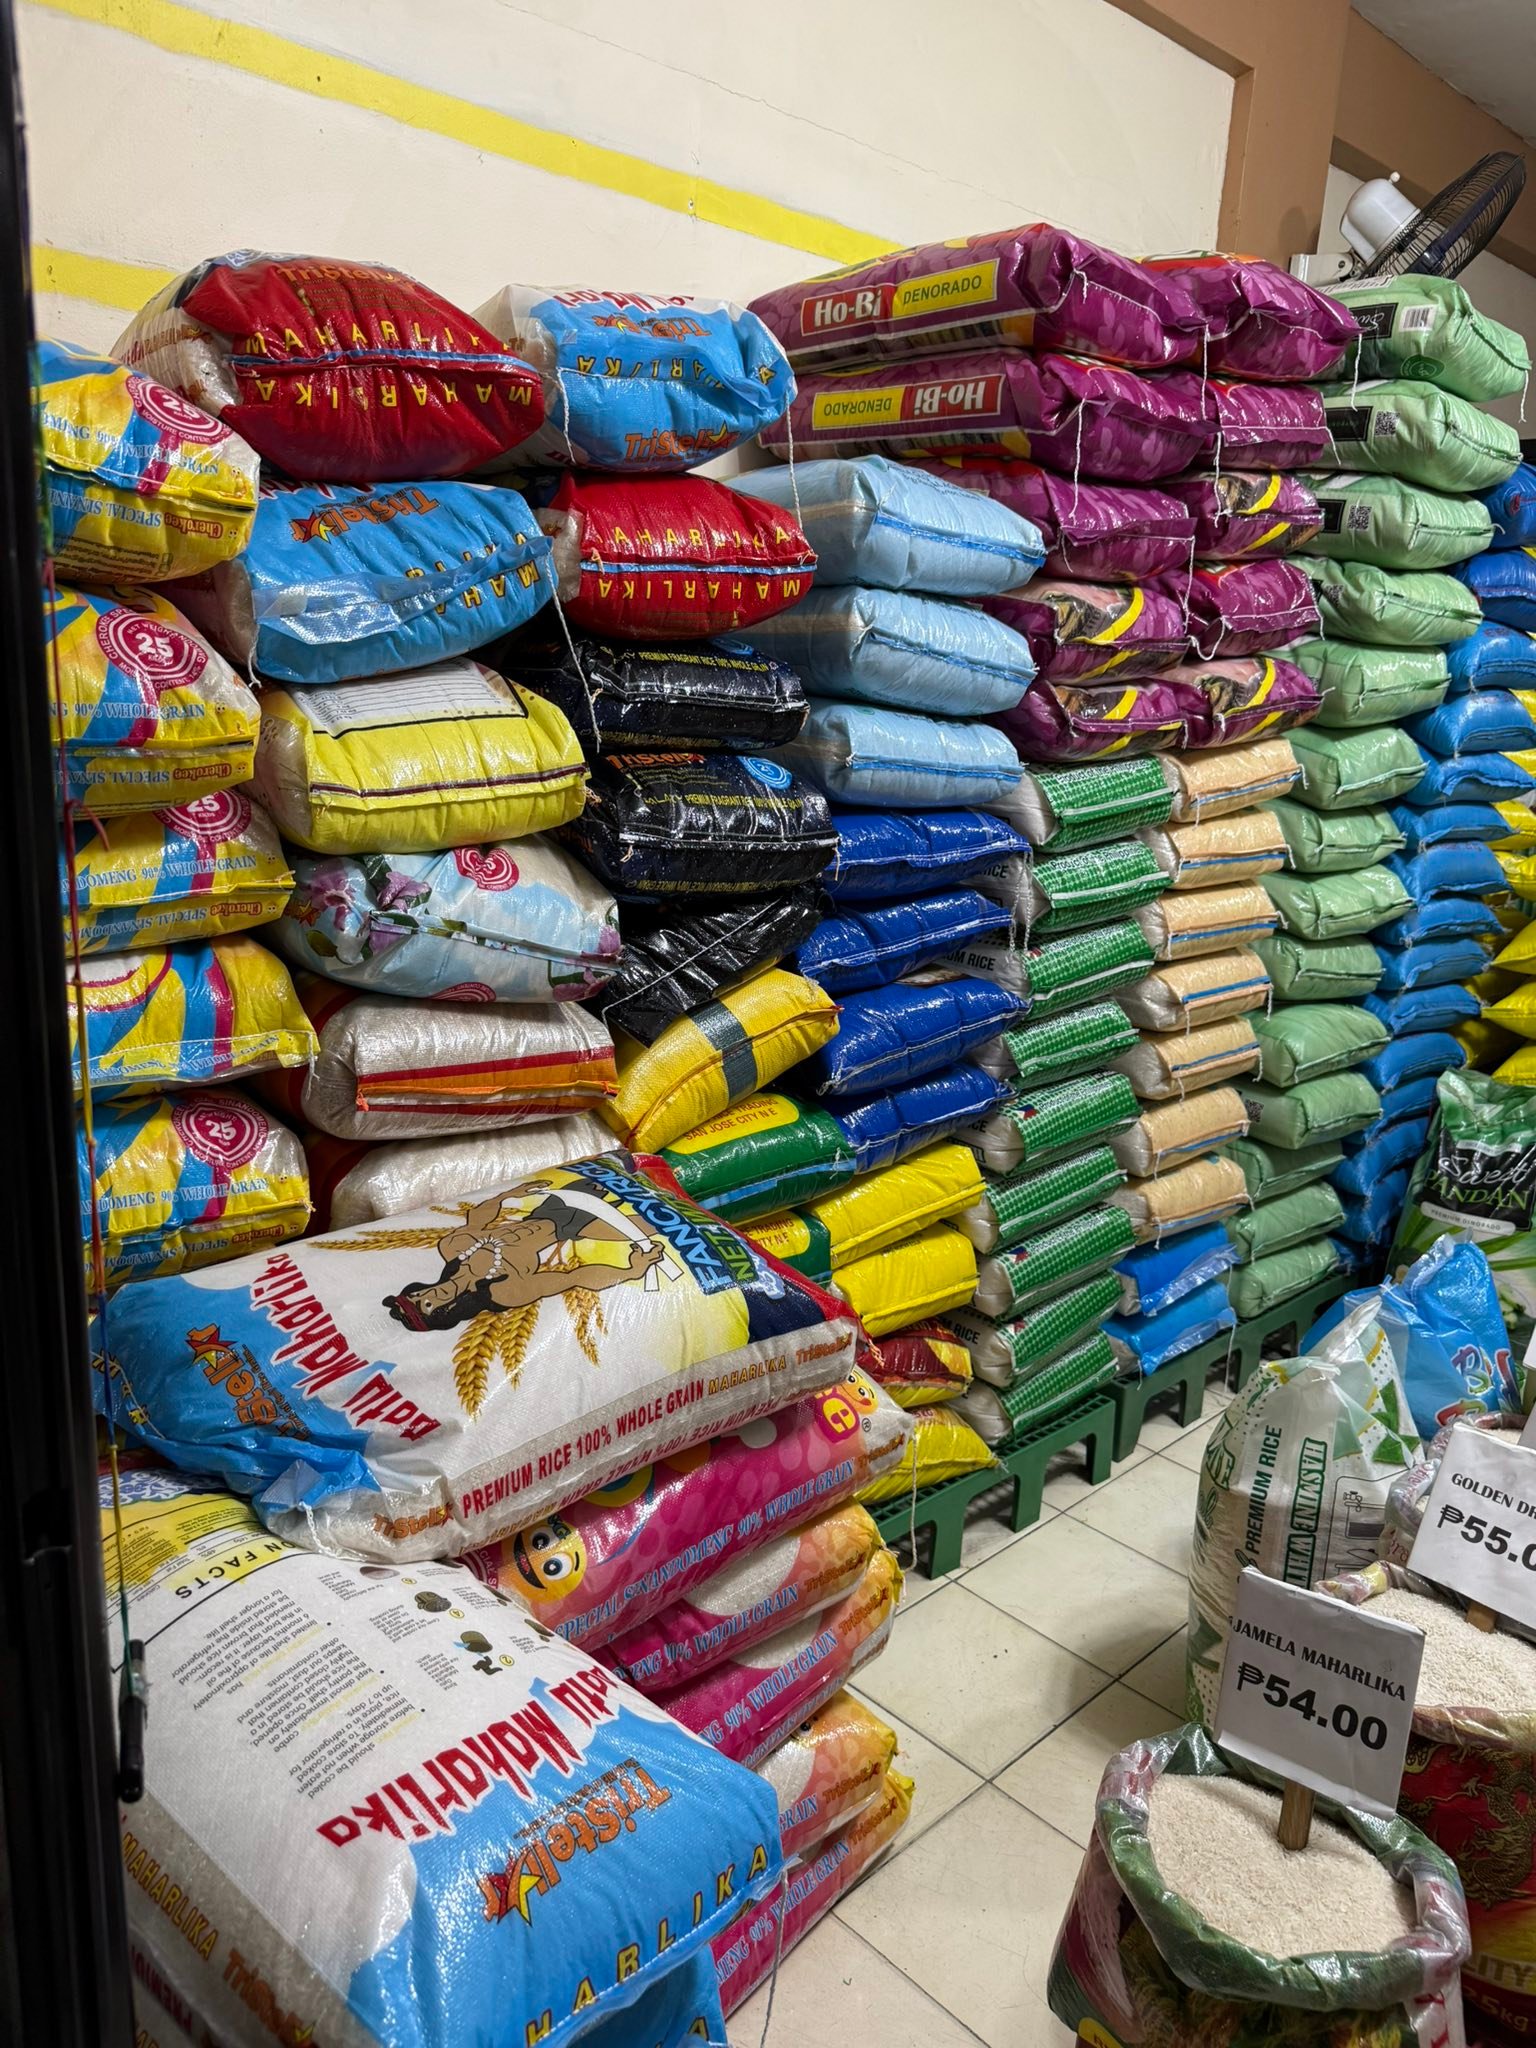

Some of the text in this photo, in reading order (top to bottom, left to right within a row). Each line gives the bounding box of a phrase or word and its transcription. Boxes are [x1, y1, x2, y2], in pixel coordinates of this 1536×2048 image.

[814, 275, 982, 328] Ho-Bi DENORADO
[823, 381, 985, 416] Ho-Bi DENORADO
[105, 501, 161, 527] SPECIAL
[165, 514, 222, 538] Cherokee
[598, 580, 801, 600] MAHARLIKA
[135, 632, 174, 658] 25
[74, 704, 102, 717] 90%
[111, 763, 232, 784] Cherokee SPECIAL
[141, 866, 166, 880] 90%
[217, 855, 256, 871] GRAIN
[155, 901, 262, 924] Cherokee SPECIAL
[968, 952, 997, 970] RICE
[684, 1128, 706, 1140] SAN
[710, 1119, 736, 1133] JOSE
[738, 1112, 759, 1124] CITY
[735, 1098, 778, 1114] TRADING
[206, 1120, 237, 1139] 25
[231, 1179, 270, 1195] GRAIN
[632, 1199, 732, 1292] FANCY
[754, 1218, 794, 1233] TRADING
[252, 1252, 369, 1397] Maharlika
[955, 1324, 981, 1344] RICE
[462, 1355, 787, 1519] PREMIUM RICE 100% WHOLE GRAIN MAHARLIKA
[766, 1480, 813, 1517] WHOLE
[814, 1456, 855, 1495] GRAIN
[1245, 1425, 1282, 1554] PREMIUM RICE
[1451, 1473, 1514, 1508] GOLDEN
[174, 1550, 258, 1600] FACTS
[237, 1596, 264, 1620] longer
[752, 1584, 799, 1623] GRAIN
[168, 1598, 278, 1680] stored inside the refrigerator
[177, 1597, 295, 1686] mended that brown rice should
[216, 1614, 303, 1678] months because the
[238, 1618, 281, 1651] bran layer.
[191, 1616, 317, 1711] limited shelf approximately
[264, 1635, 339, 1692] other contaminants.
[748, 1664, 798, 1712] WHOLE
[797, 1627, 838, 1670] GRAIN
[1233, 1616, 1406, 1701] JAMELA MAHARLIKA
[226, 1680, 243, 1696] has
[236, 1640, 346, 1724] keeps dust, moisture and
[246, 1646, 353, 1727] highly closed that
[266, 1662, 346, 1723] rice should be stored
[283, 1666, 352, 1721] pantry shelf. Once
[343, 1682, 392, 1721] up days.
[381, 1688, 400, 1705] rice,
[267, 1665, 373, 1745] kept almost immediately on
[360, 1699, 383, 1720] place
[1238, 1661, 1387, 1751] ₱54.00
[272, 1729, 300, 1753] canbe
[295, 1693, 407, 1782] immediately. To store cooked
[296, 1702, 414, 1794] before storage when not eaten
[299, 1726, 346, 1766] refrigerator
[287, 1763, 302, 1777] for
[306, 1741, 376, 1799] should be cooled
[316, 1699, 583, 1847] Maharlika
[812, 1839, 849, 1886] GRAIN
[121, 1832, 219, 1961] MAHARLIKA
